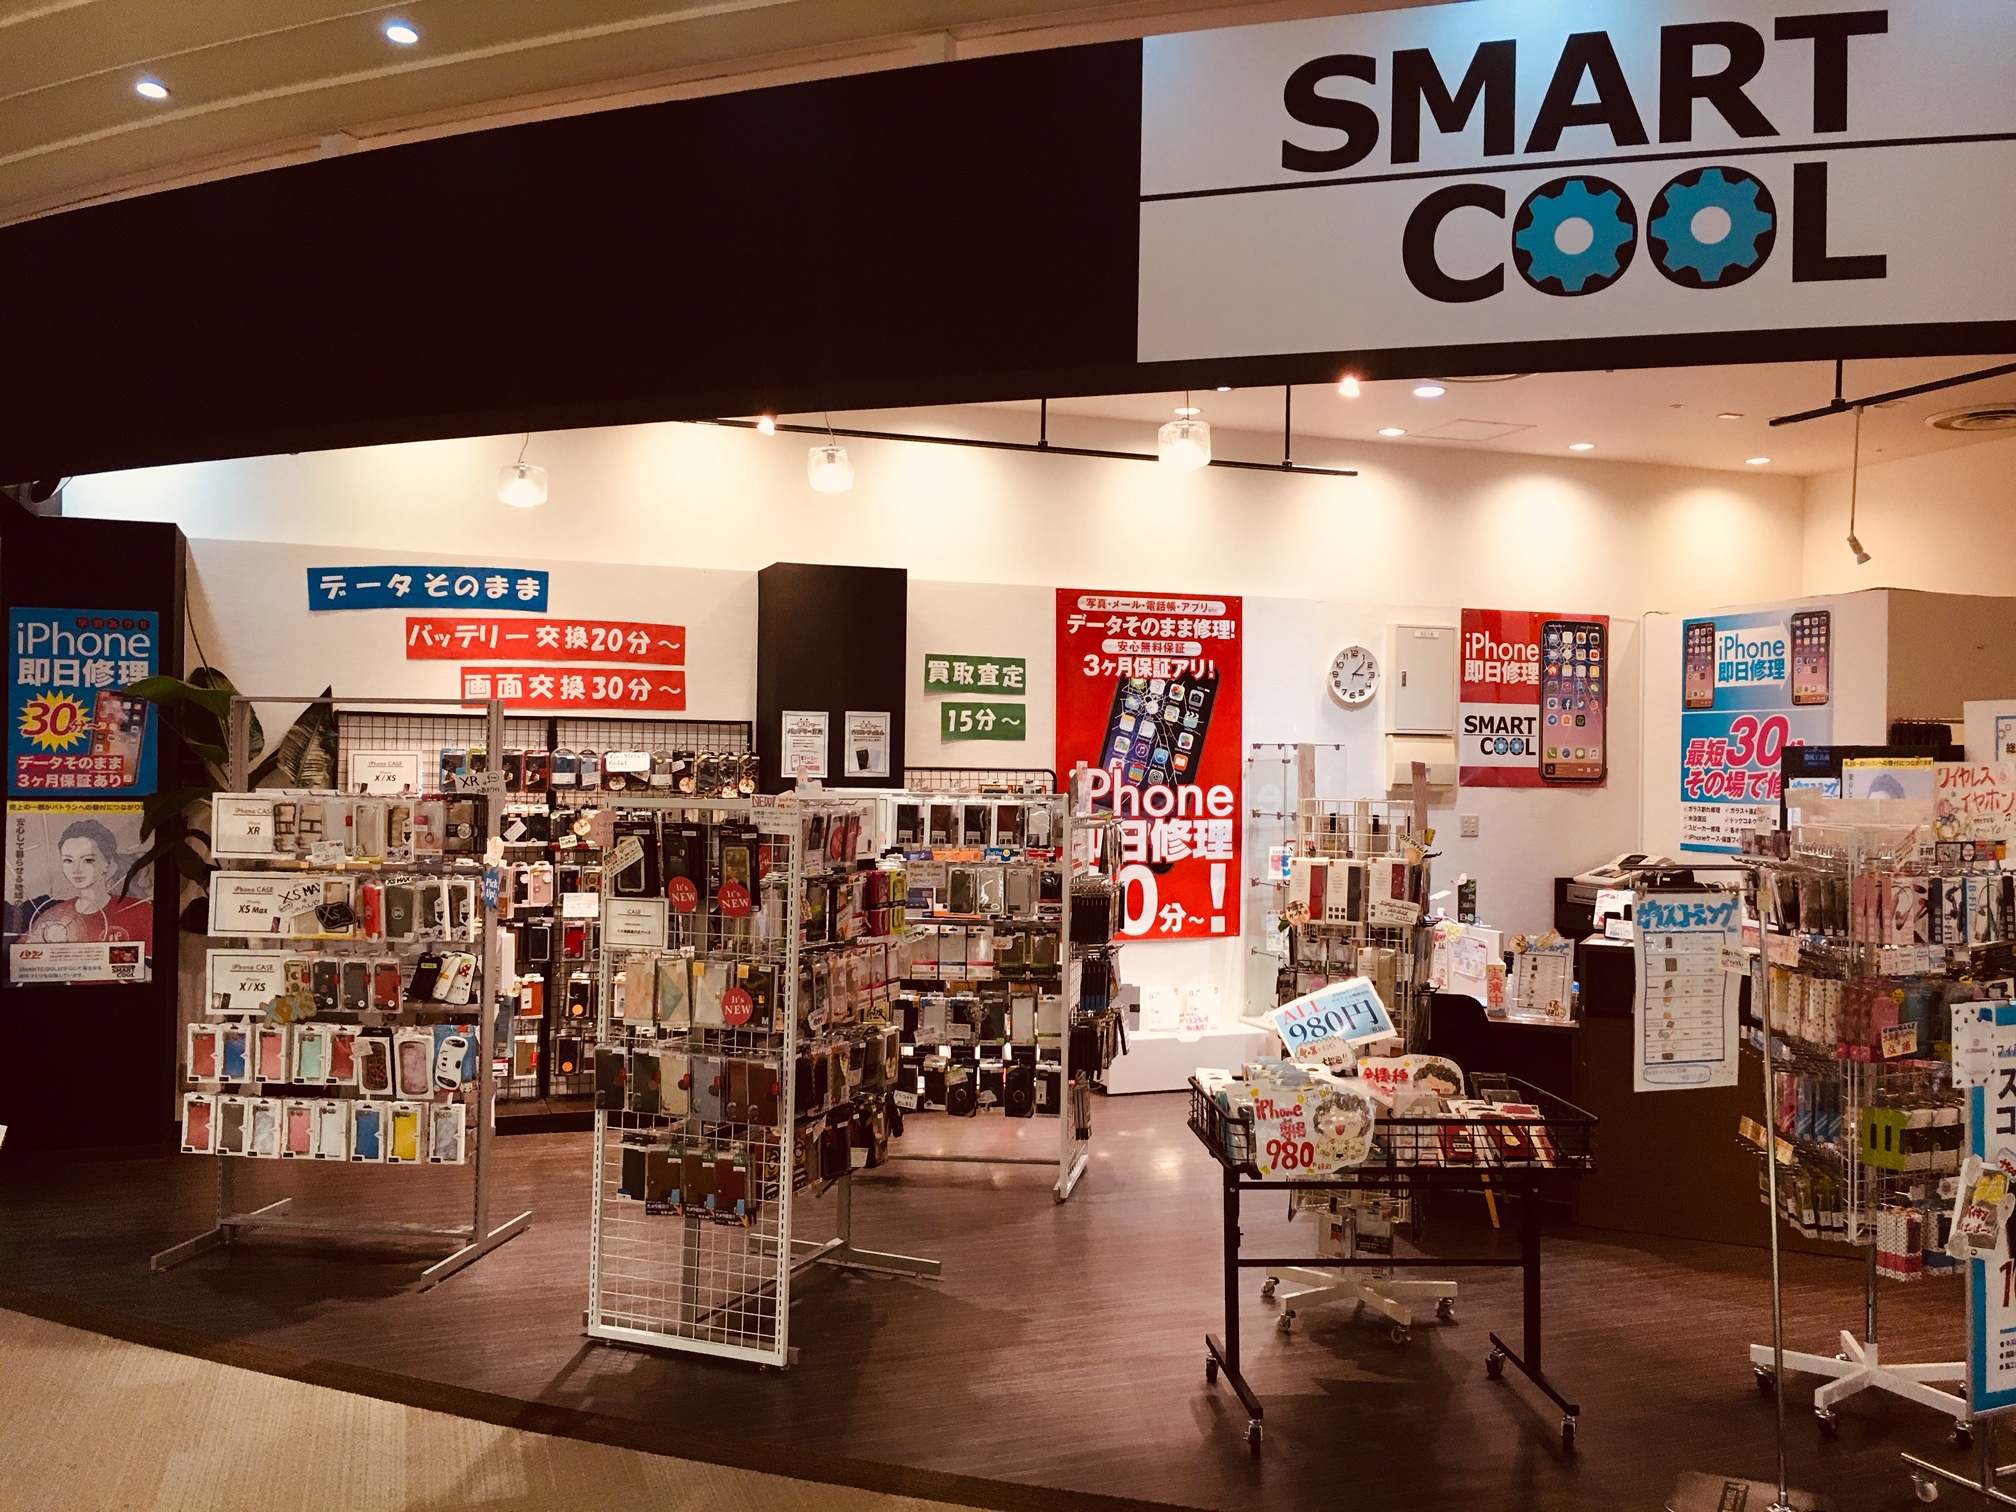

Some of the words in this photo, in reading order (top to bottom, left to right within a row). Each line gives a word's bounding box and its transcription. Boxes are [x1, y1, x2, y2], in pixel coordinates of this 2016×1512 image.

[1281, 10, 1888, 172] SMART
[1402, 162, 1887, 303] COOL
[1066, 613, 1236, 640] データそのまま修理!
[17, 622, 151, 658] iPhone
[1465, 631, 1540, 661] iPhone
[1117, 641, 1186, 654] 安心無料保証
[1350, 649, 1359, 658] 12
[1718, 633, 1785, 661] iPhone
[1342, 652, 1349, 661] 11
[1362, 653, 1366, 662] 1
[1335, 660, 1345, 670] 10
[1367, 661, 1374, 669] 2
[1718, 658, 1786, 684] 即日修理
[17, 658, 149, 688] 即日修理
[927, 660, 1025, 688] 買取査定
[1331, 670, 1339, 679] 9
[1368, 671, 1376, 679] 3
[1464, 660, 1540, 685] 即日修理
[1334, 680, 1341, 688] 8
[1365, 682, 1372, 690] 4
[1341, 688, 1348, 696] 7
[1348, 691, 1356, 700] 6
[1358, 689, 1365, 697] 5
[1464, 715, 1536, 735] SMART
[1480, 736, 1536, 756] COOL
[18, 756, 122, 771] データそのまま
[459, 776, 480, 790] XR
[1937, 766, 1996, 789] ワイヤレス
[1069, 767, 1235, 817] Phone
[247, 826, 261, 836] XR
[486, 877, 498, 889] Pick
[675, 884, 689, 892] It's
[486, 888, 497, 901] Up!
[671, 893, 697, 902] NEW
[726, 889, 741, 898] It's
[721, 899, 750, 909] NEW
[1488, 966, 1504, 1007] 実演中
[731, 995, 745, 1004] It's
[724, 1005, 751, 1015] NEW
[1283, 999, 1327, 1026] ALL
[1288, 999, 1380, 1043] 980円
[1254, 1097, 1304, 1121] iPhone
